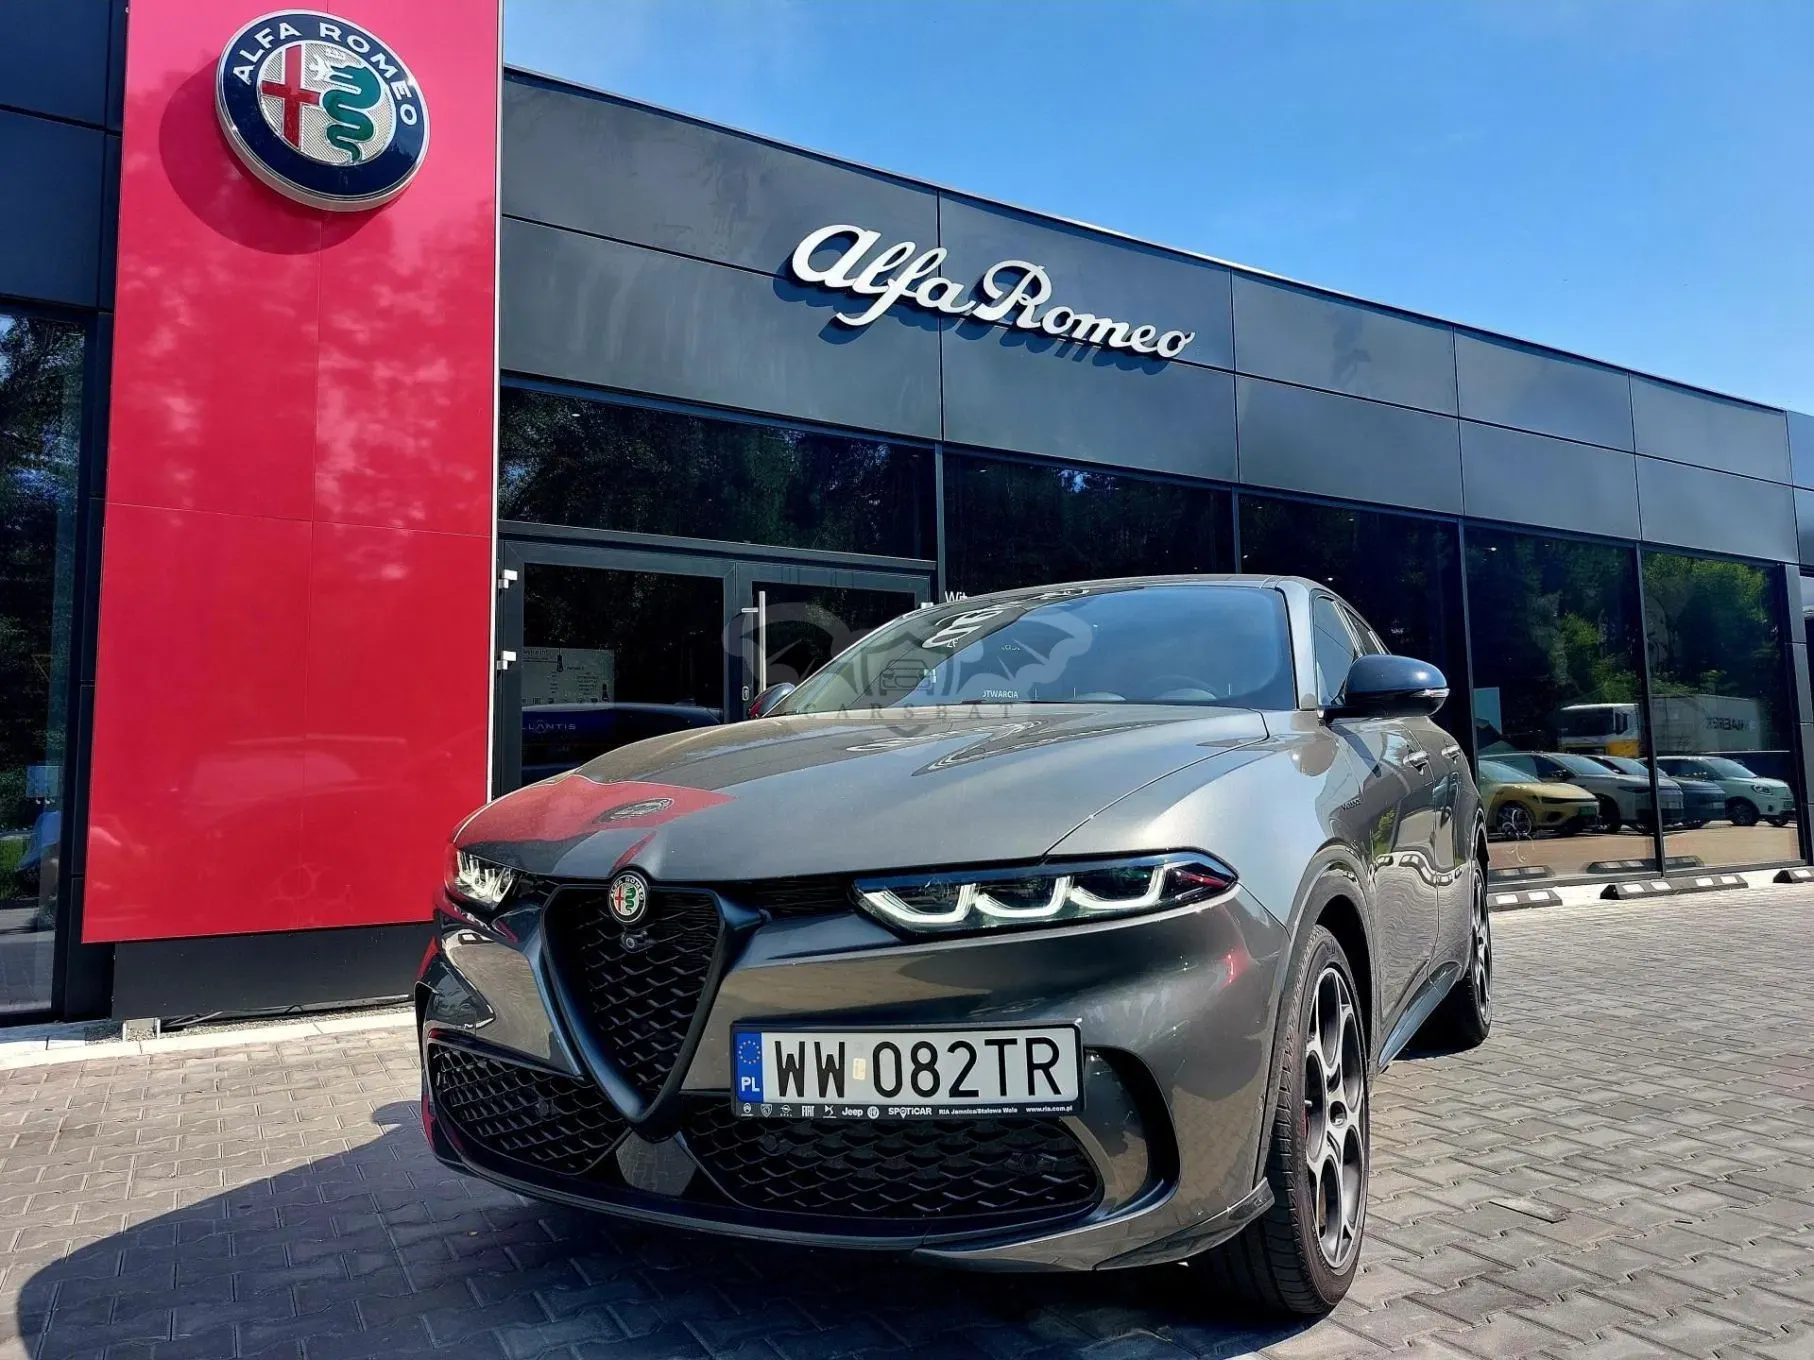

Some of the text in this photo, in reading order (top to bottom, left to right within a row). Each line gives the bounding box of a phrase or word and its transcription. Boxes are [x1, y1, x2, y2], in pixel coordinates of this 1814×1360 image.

[233, 22, 418, 126] ALFA ROMEO
[970, 260, 1196, 358] Romeo
[741, 1076, 760, 1092] PL
[774, 1037, 1063, 1098] WW 082TR
[841, 1106, 864, 1117] Jeep
